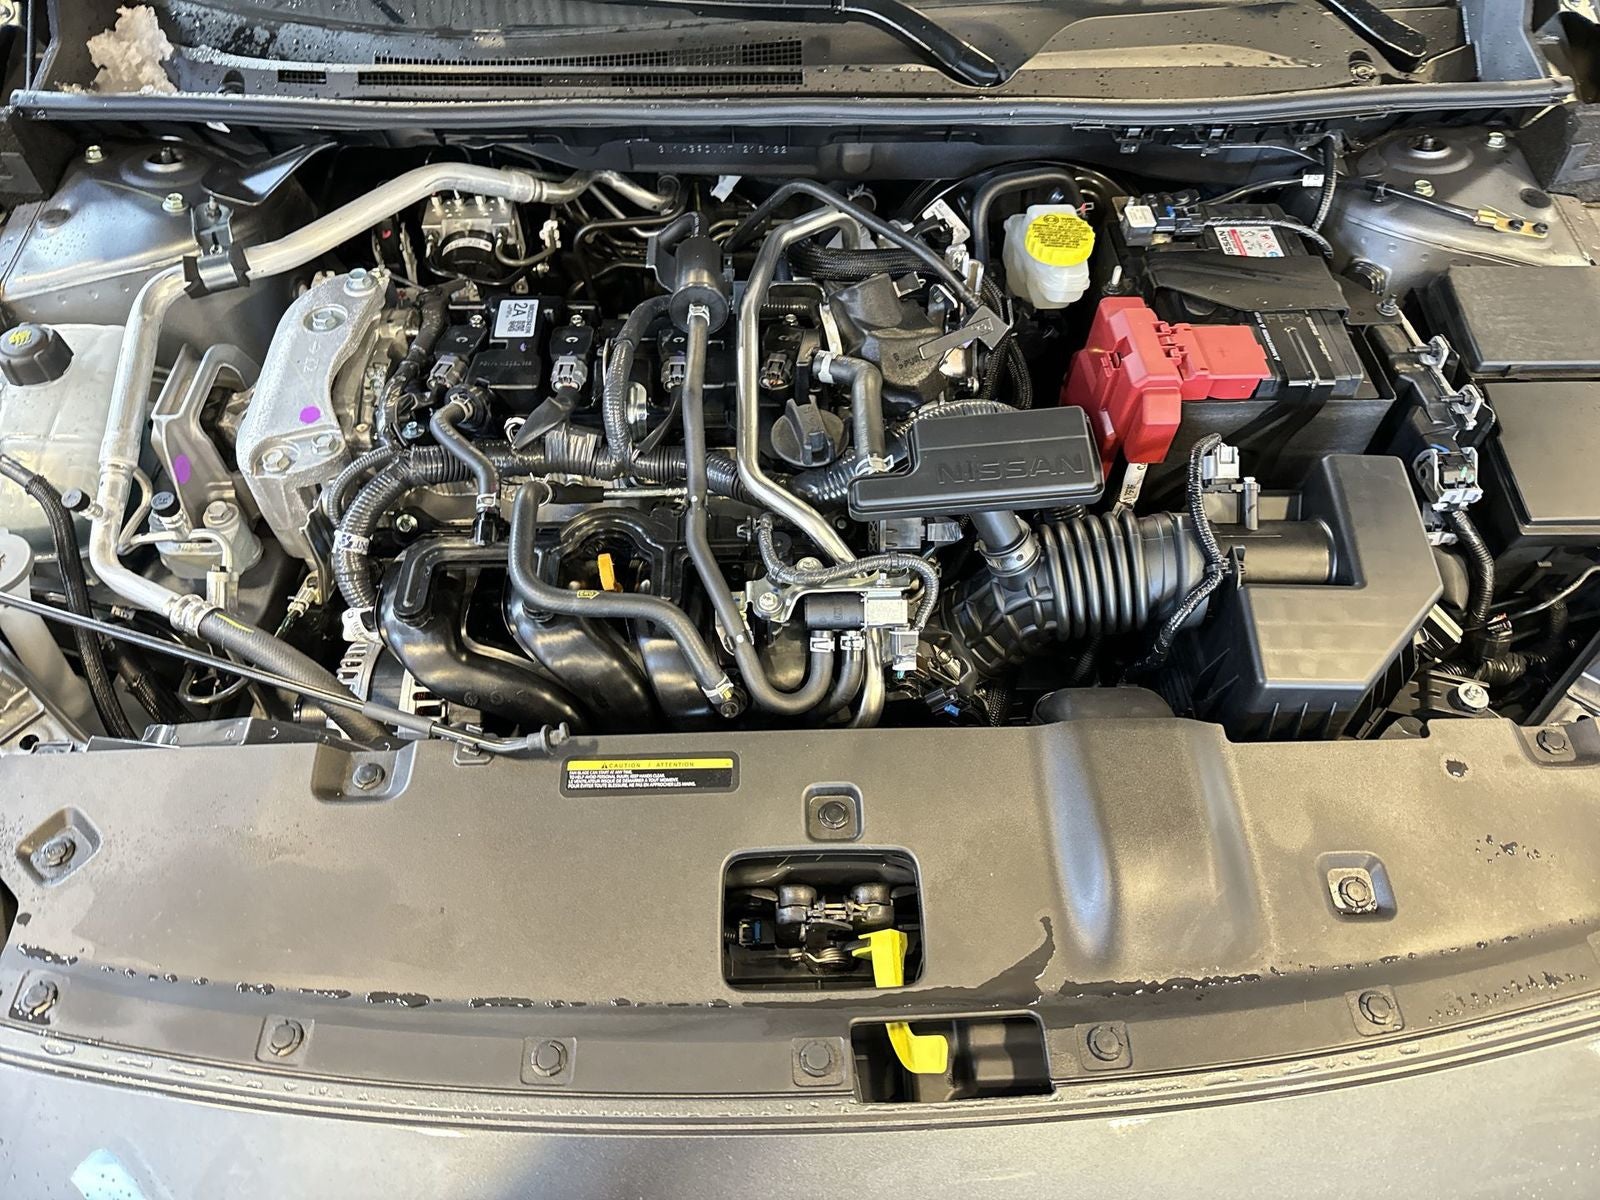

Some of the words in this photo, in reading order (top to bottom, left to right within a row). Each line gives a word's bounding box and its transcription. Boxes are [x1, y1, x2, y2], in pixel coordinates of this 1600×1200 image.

[1218, 230, 1234, 254] ISSAN
[512, 303, 528, 317] 2A
[936, 453, 1086, 485] NISSAN
